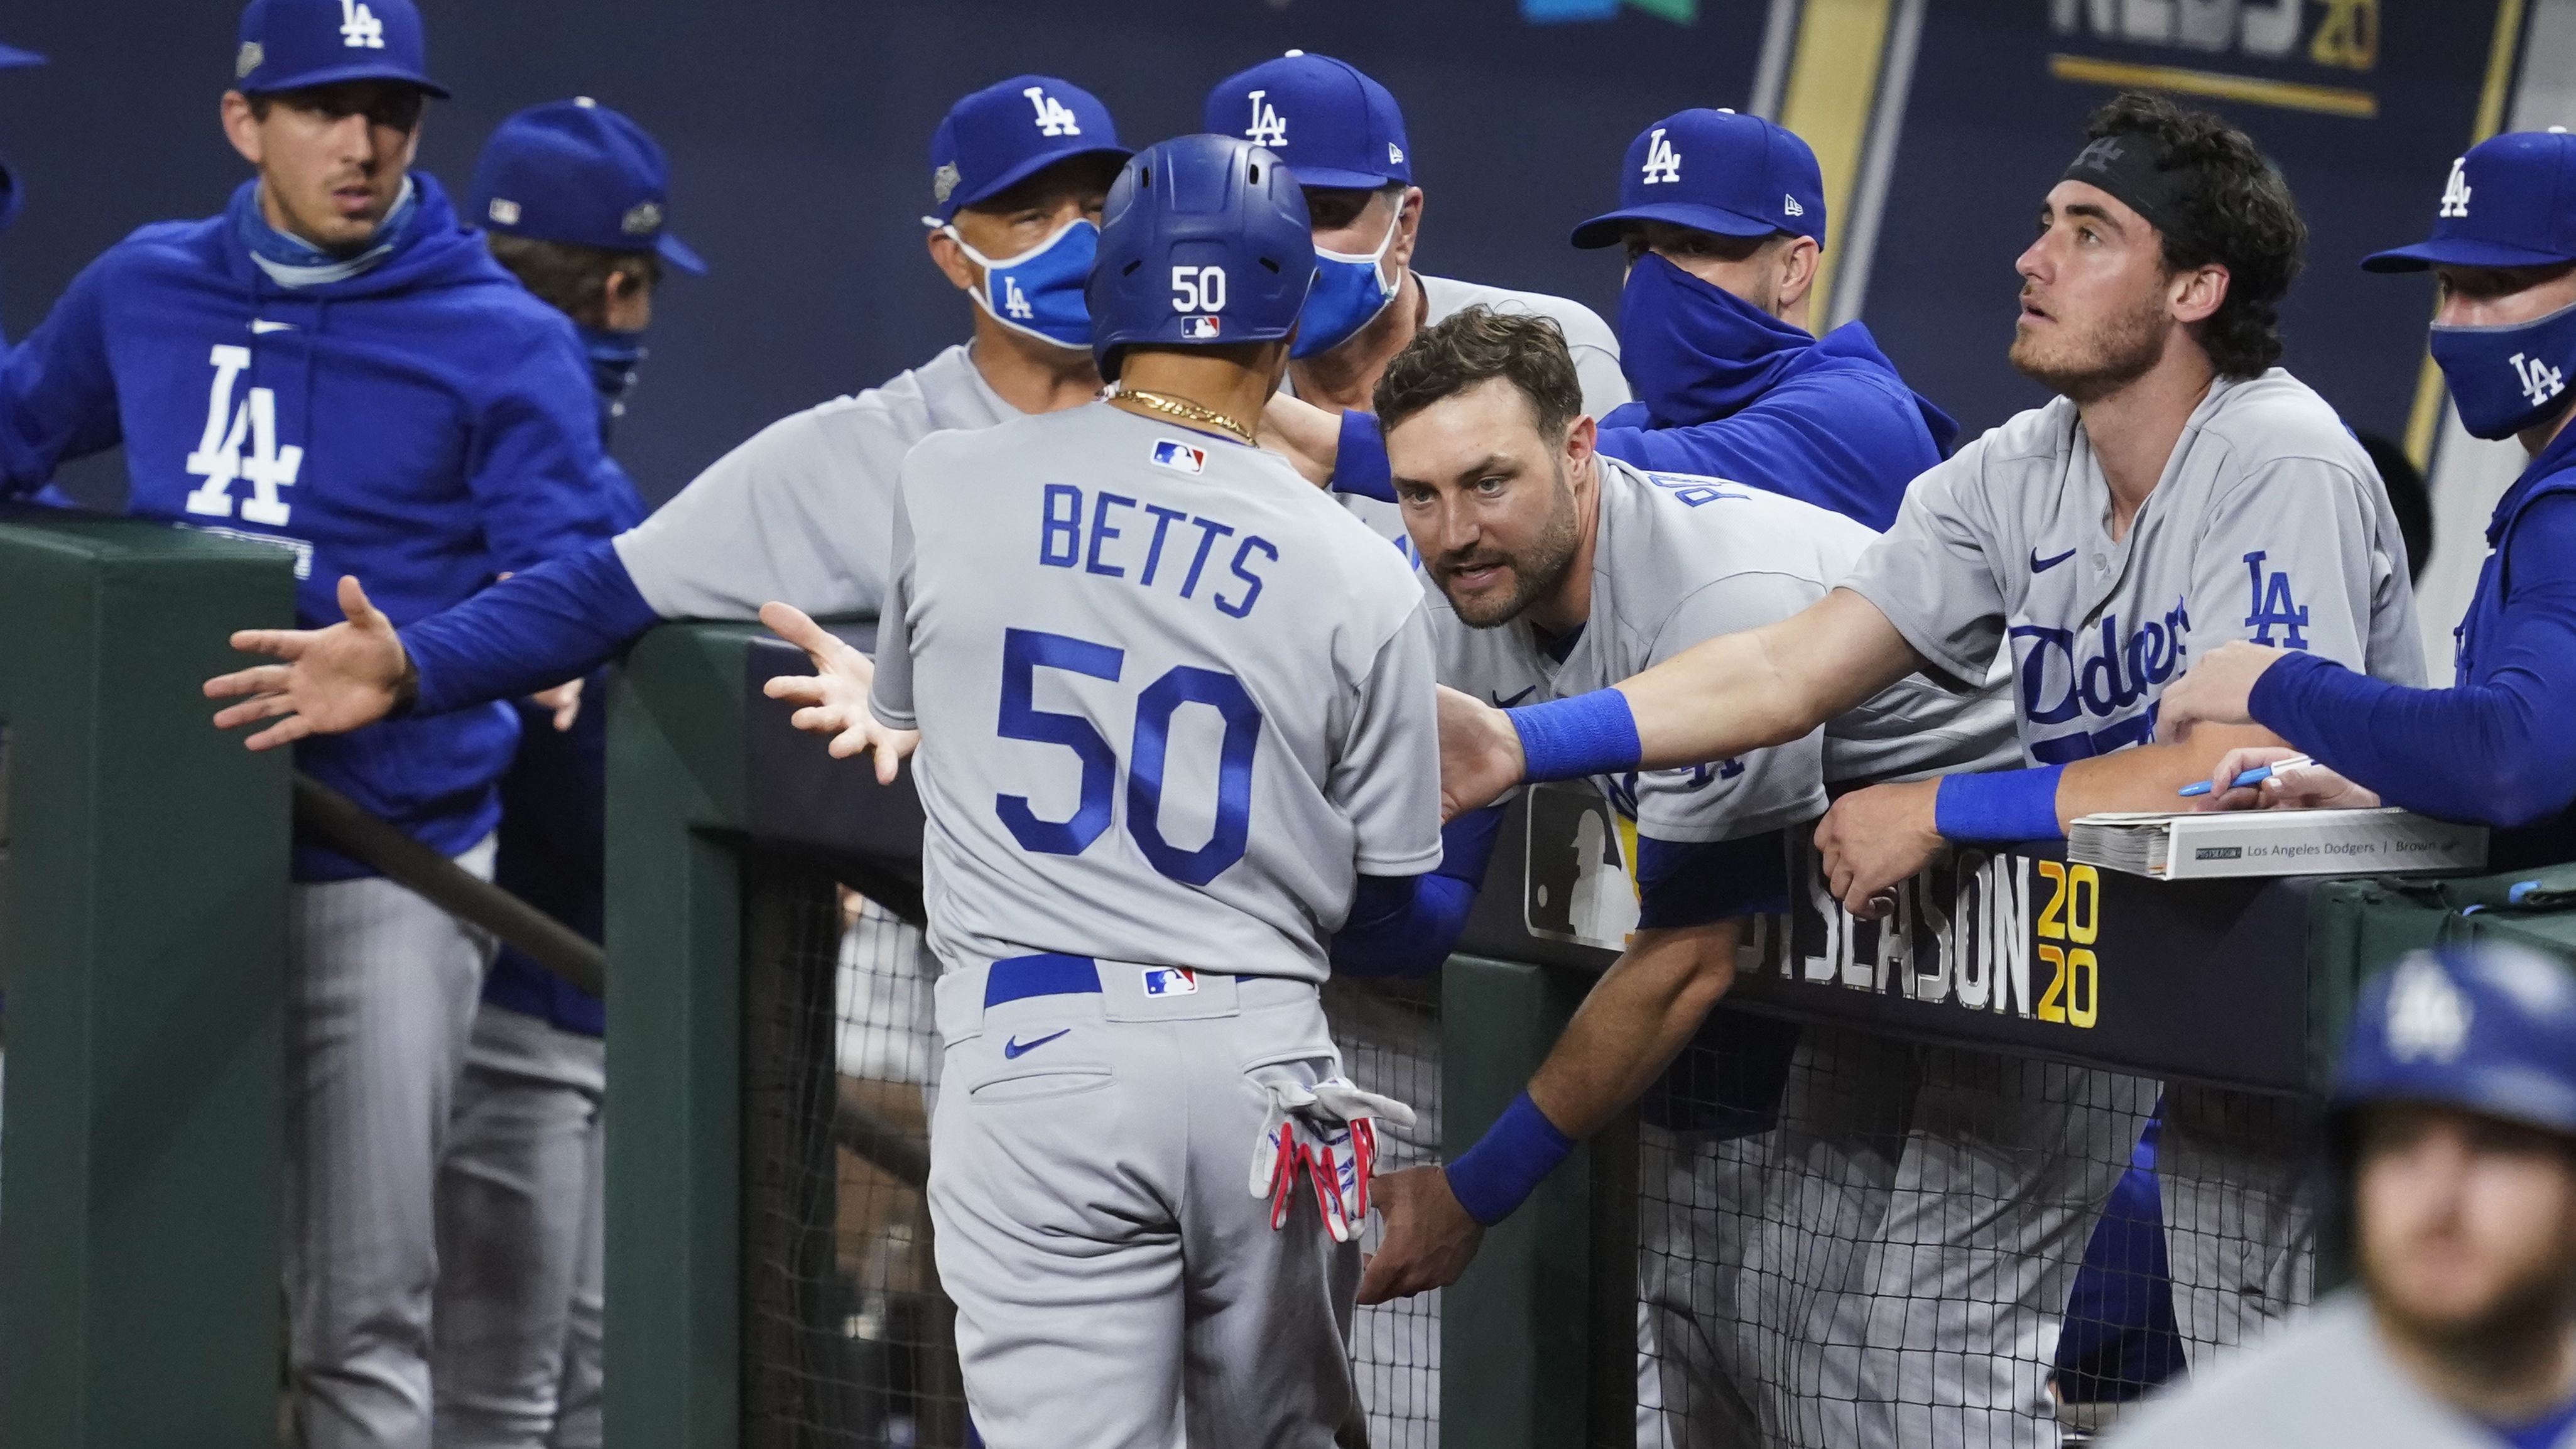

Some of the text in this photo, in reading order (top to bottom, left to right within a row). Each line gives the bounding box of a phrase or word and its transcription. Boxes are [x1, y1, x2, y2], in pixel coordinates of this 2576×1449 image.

[340, 0, 384, 48] LA
[1023, 87, 1081, 136] LA
[1246, 90, 1288, 146] LA
[1642, 128, 1682, 185] LA
[2440, 156, 2472, 217] LA
[1004, 276, 1034, 319] LA
[1171, 266, 1226, 312] 50
[2509, 352, 2565, 406] LA
[185, 344, 304, 526] LA
[1039, 483, 1279, 619] BETTS
[2242, 550, 2309, 651] LA
[996, 627, 1261, 886] 50
[2247, 845, 2268, 857] Los
[2271, 844, 2320, 858] Angeles
[2324, 842, 2375, 857] Dodgers
[2038, 860, 2099, 945] 20
[2038, 943, 2099, 1029] 20
